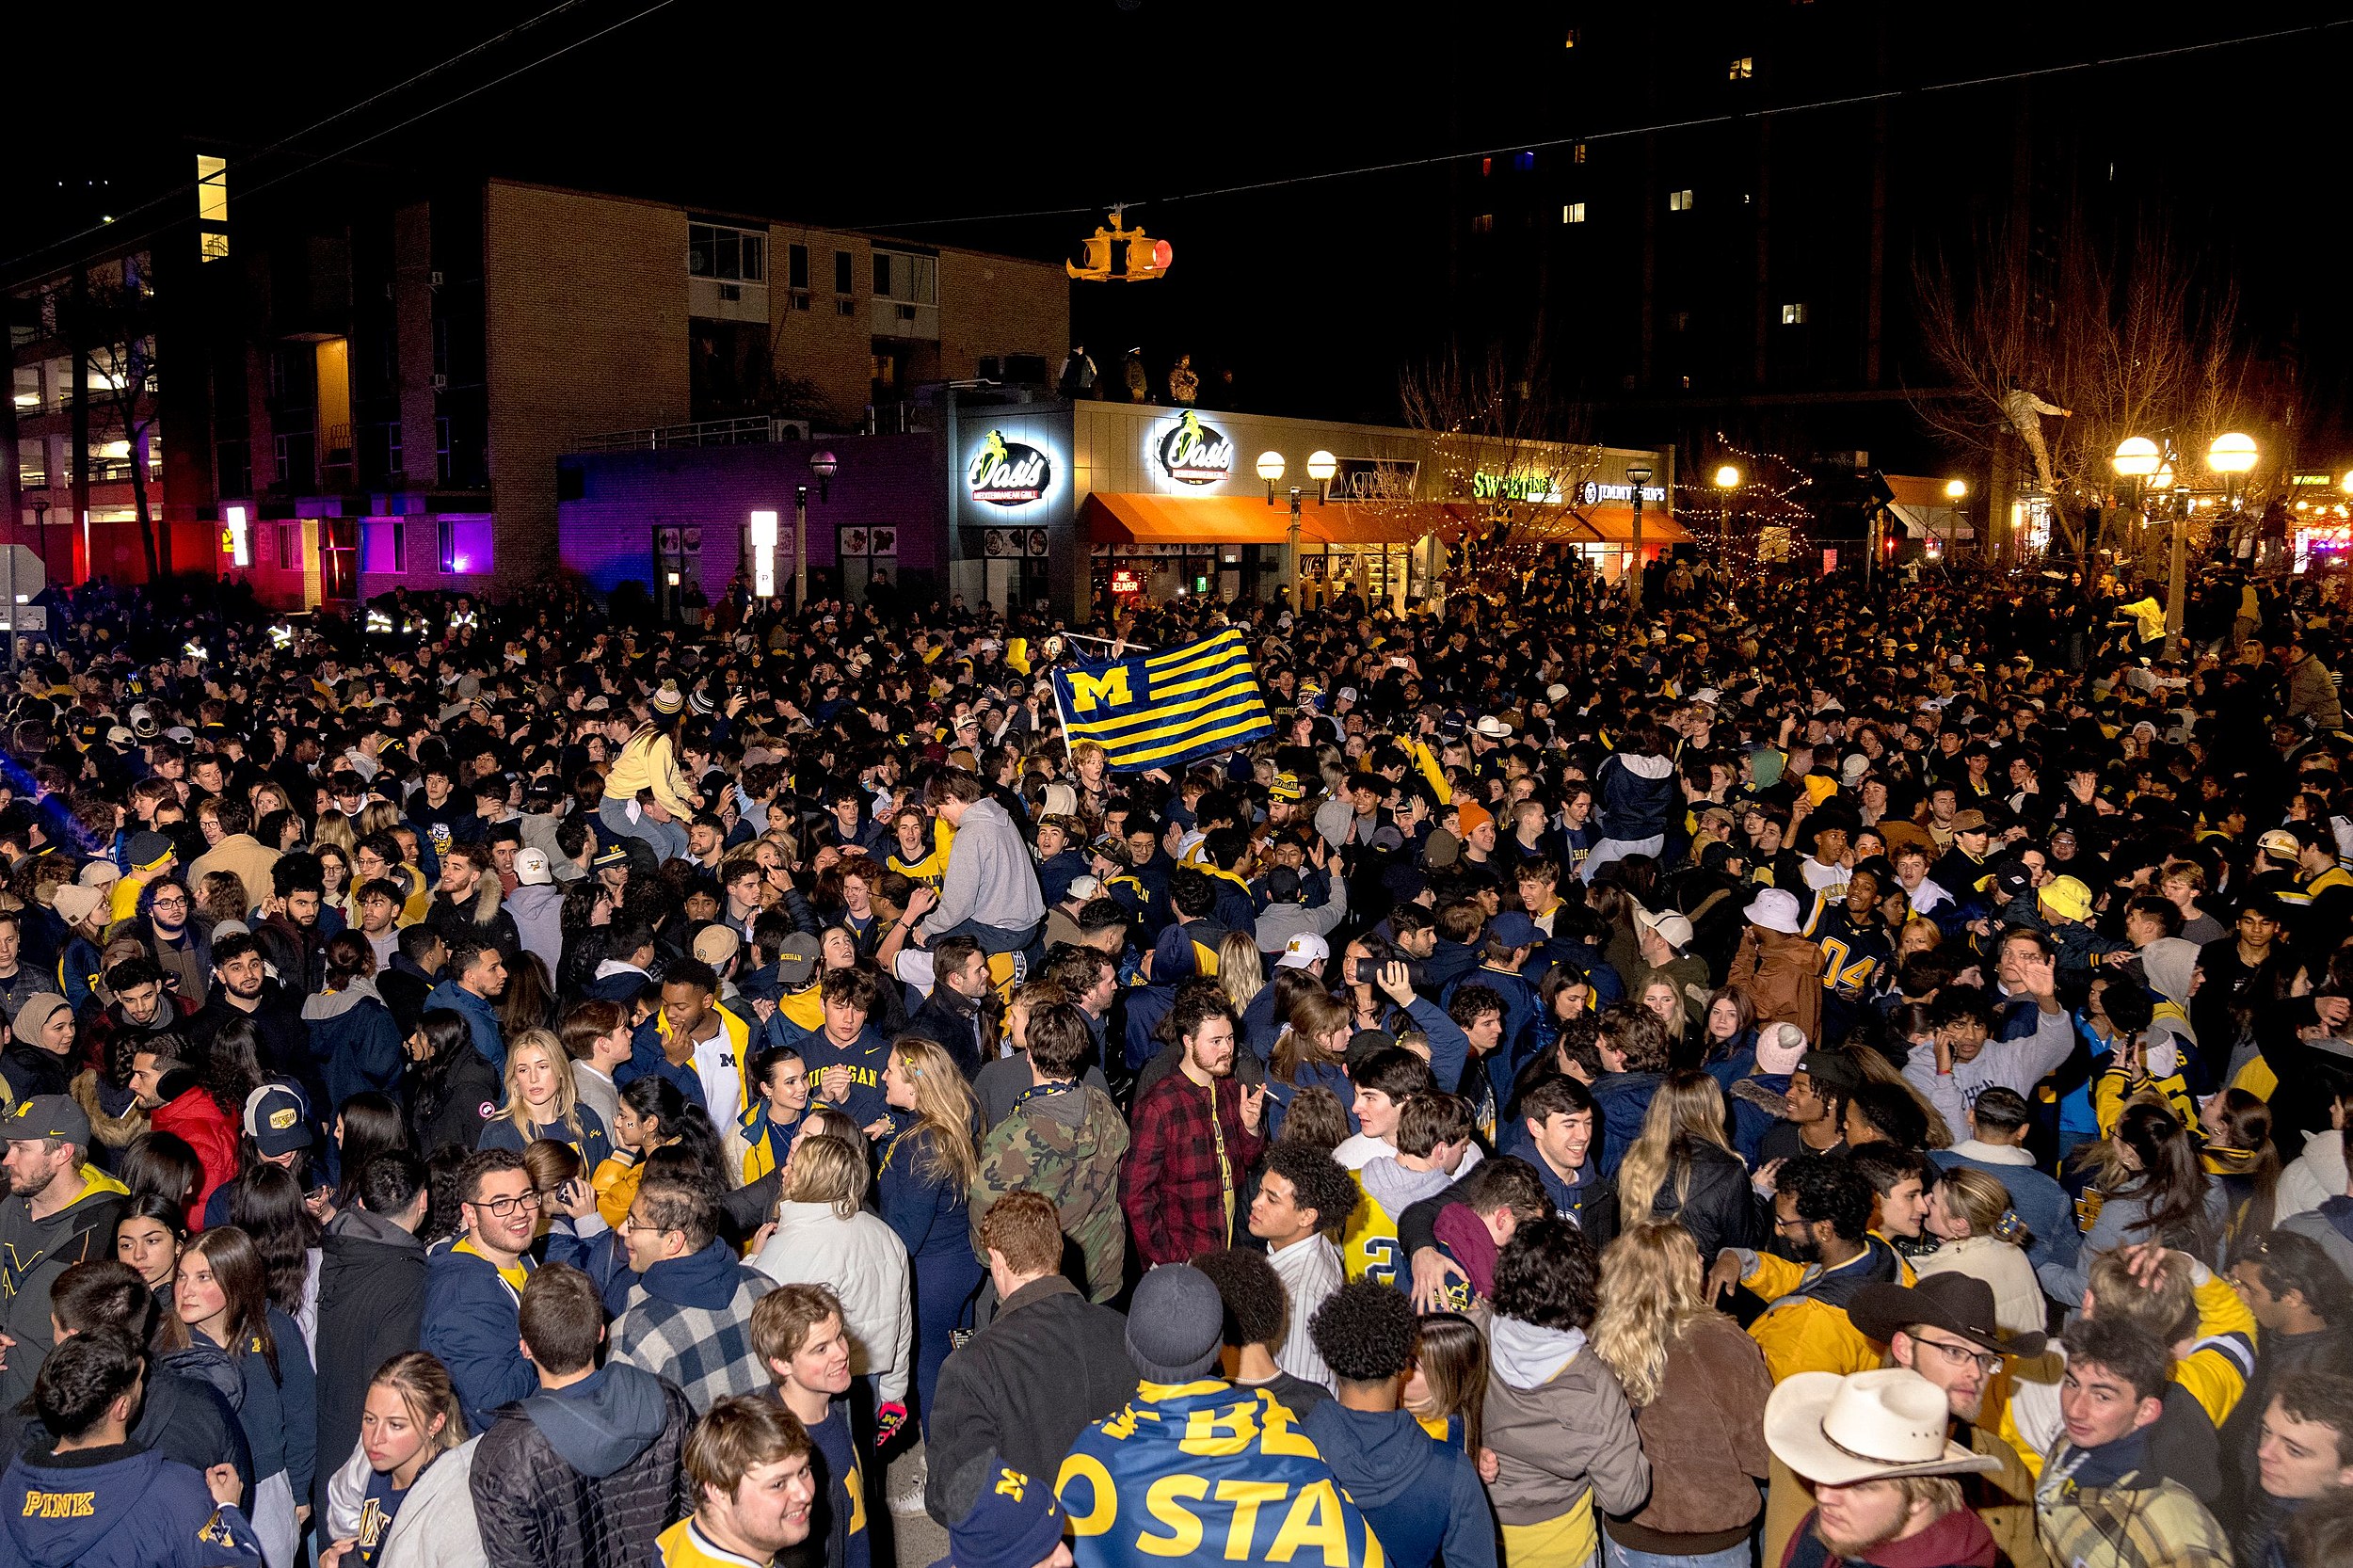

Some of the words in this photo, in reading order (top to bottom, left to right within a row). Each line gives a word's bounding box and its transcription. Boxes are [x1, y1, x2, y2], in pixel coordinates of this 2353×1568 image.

[1168, 426, 1234, 469] Oasis
[967, 447, 1045, 490] Oasis
[1597, 484, 1632, 504] JIMMY
[1117, 571, 1131, 581] WE
[1065, 665, 1132, 712] M
[1273, 794, 1285, 804] M
[1287, 940, 1301, 952] M
[780, 952, 803, 963] MICHIGAN
[719, 1053, 738, 1068] M
[808, 1064, 878, 1089] ICGAN
[994, 1466, 1029, 1503] M
[22, 1490, 96, 1519] PINK
